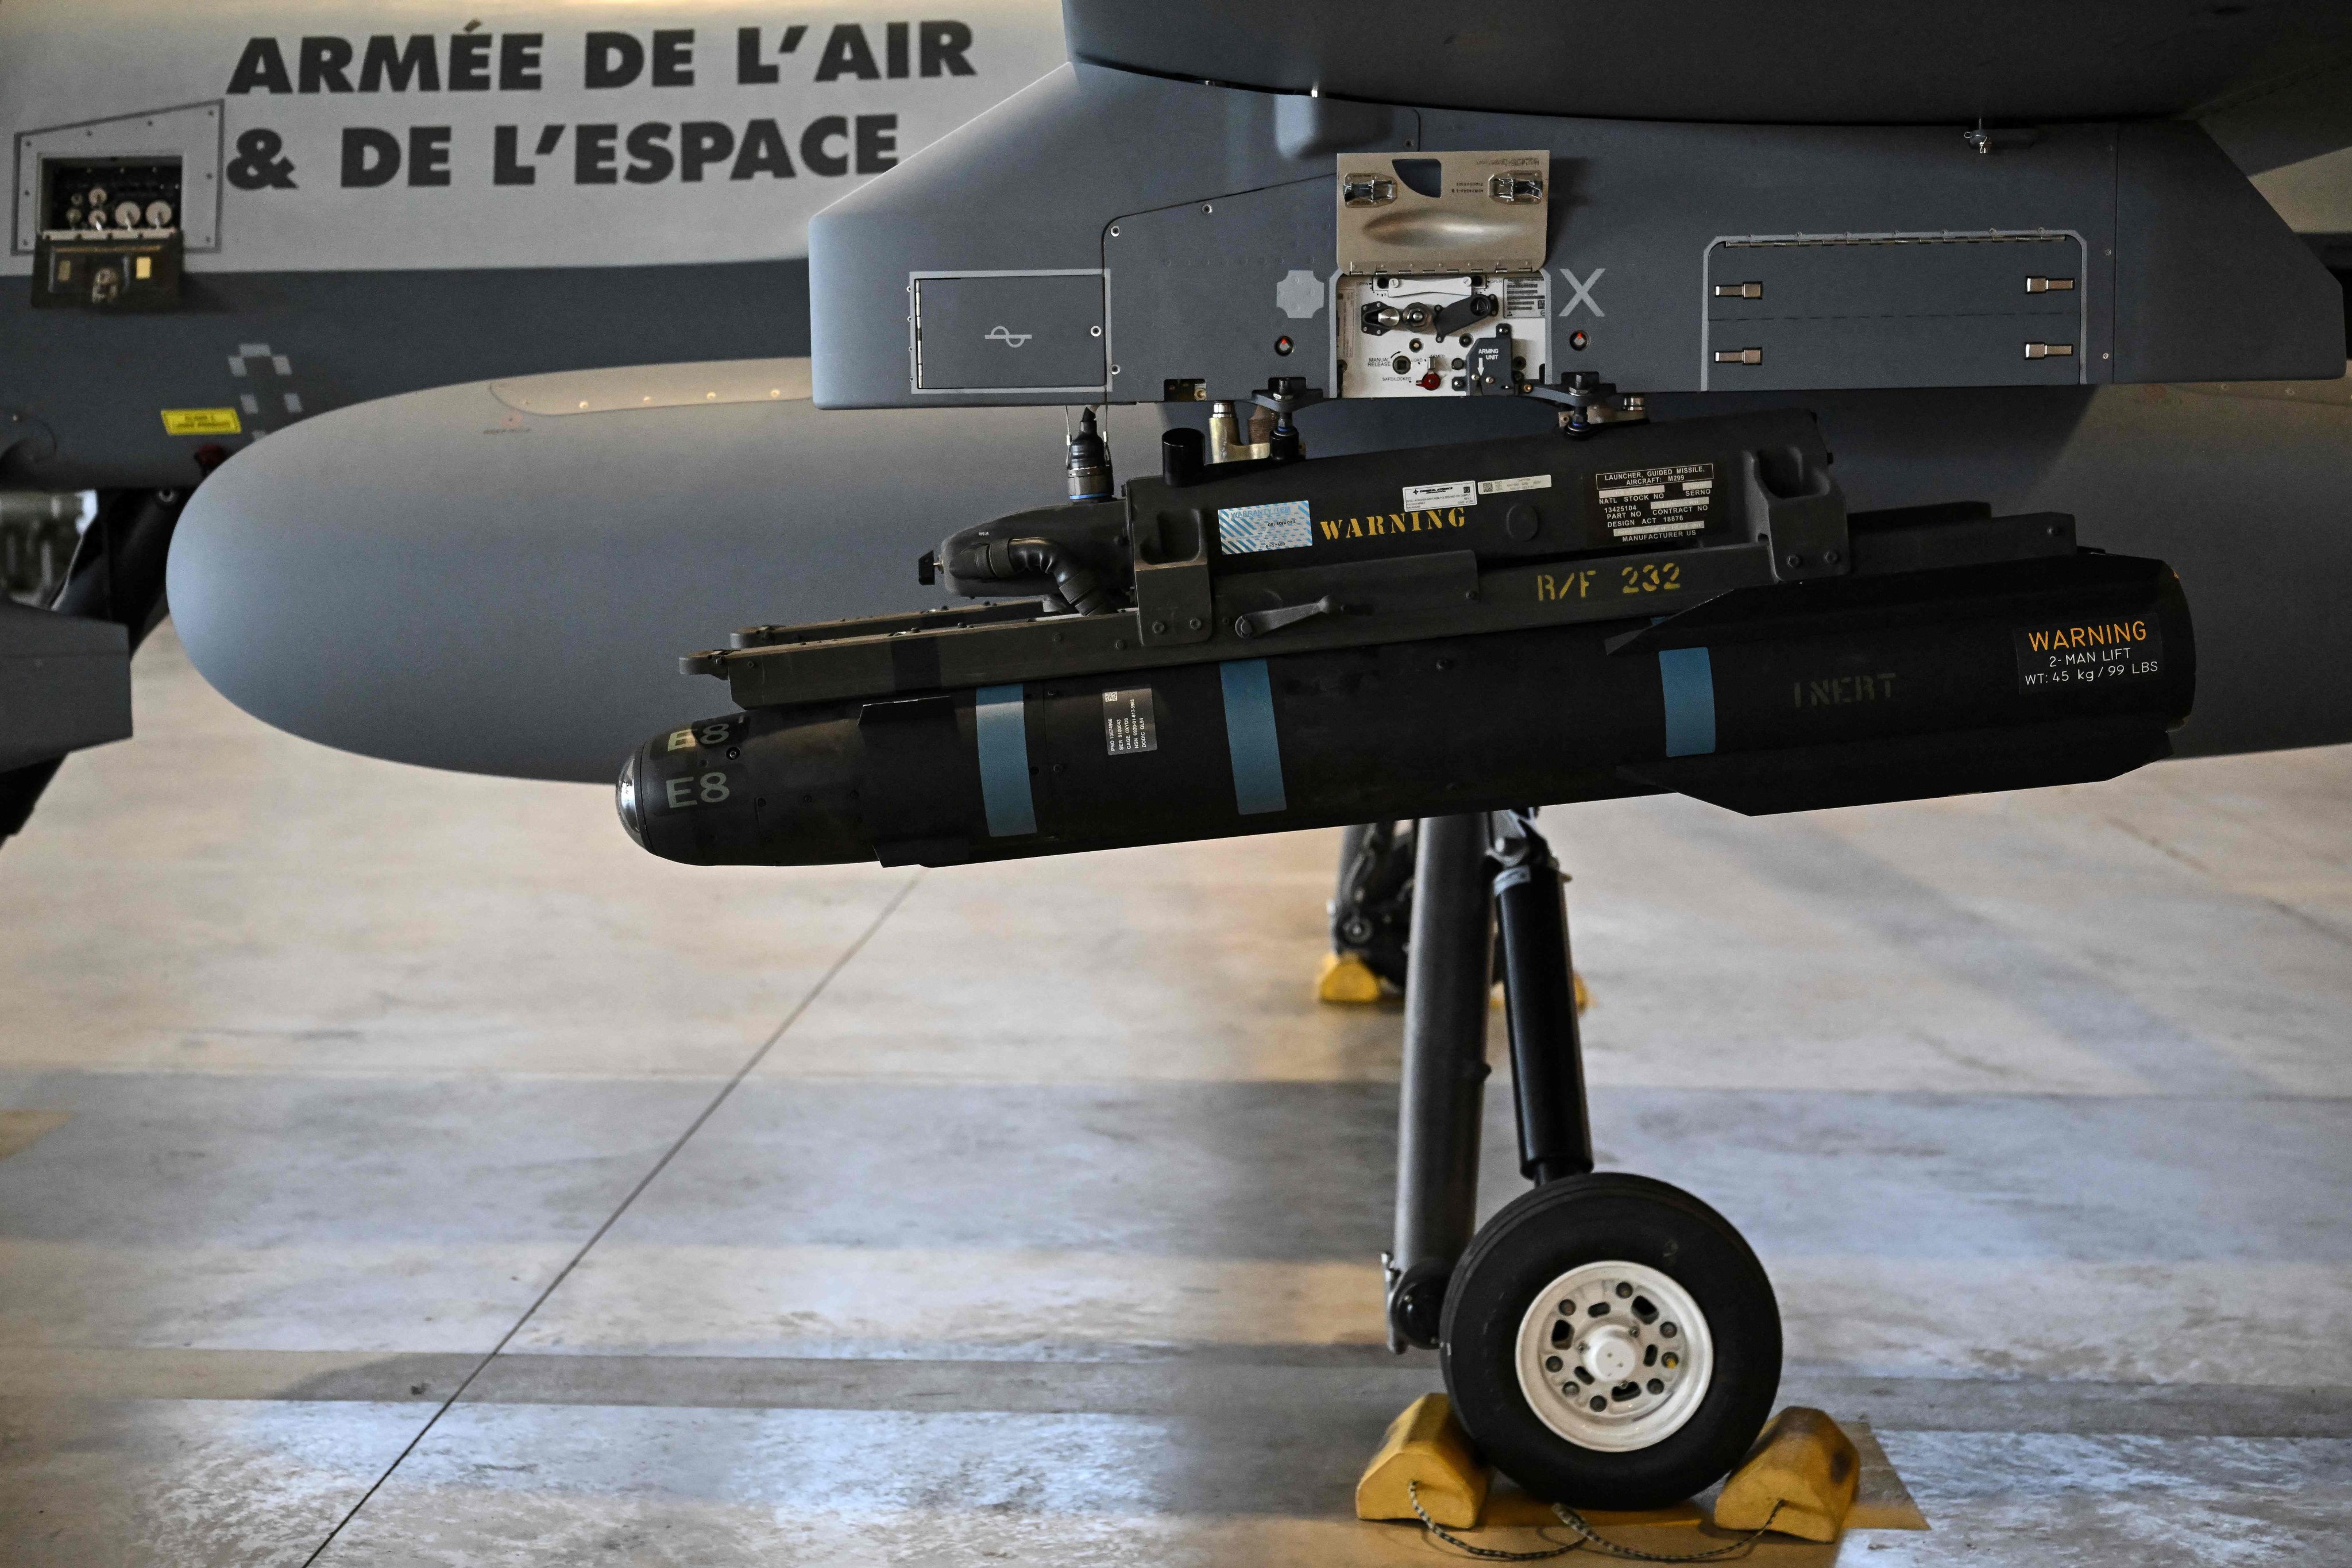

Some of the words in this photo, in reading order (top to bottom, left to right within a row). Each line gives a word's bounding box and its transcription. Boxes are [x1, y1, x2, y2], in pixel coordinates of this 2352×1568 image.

[226, 19, 543, 95] ARMÉE
[584, 28, 696, 90] DE
[737, 20, 978, 85] L'AIR
[226, 128, 299, 190] &
[340, 125, 452, 189] DE
[493, 114, 898, 186] L'ESPACE
[1605, 473, 1643, 481] LAUNCHER,
[1647, 469, 1673, 477] GUIDED
[1676, 466, 1705, 474] MISSILE,
[1626, 478, 1662, 486] AIRCRAFT:
[1624, 495, 1649, 503] STOCK
[1685, 489, 1711, 497] SERNO
[1231, 508, 1271, 518] WARRANTY
[1604, 505, 1637, 513] 13425104
[1652, 506, 1693, 516] CONTRACT
[1320, 507, 1465, 540] WARNING
[1608, 520, 1635, 528] DESIGN
[1622, 531, 1683, 542] MANUFACTURER
[1537, 570, 1596, 601] R/F
[1621, 562, 1681, 594] 232
[2029, 621, 2146, 652] WARNING
[2103, 647, 2131, 661] LIFT
[2132, 661, 2158, 674] LBS
[1793, 672, 1899, 708] INERT
[667, 723, 730, 752] E8
[666, 772, 731, 809] E8
